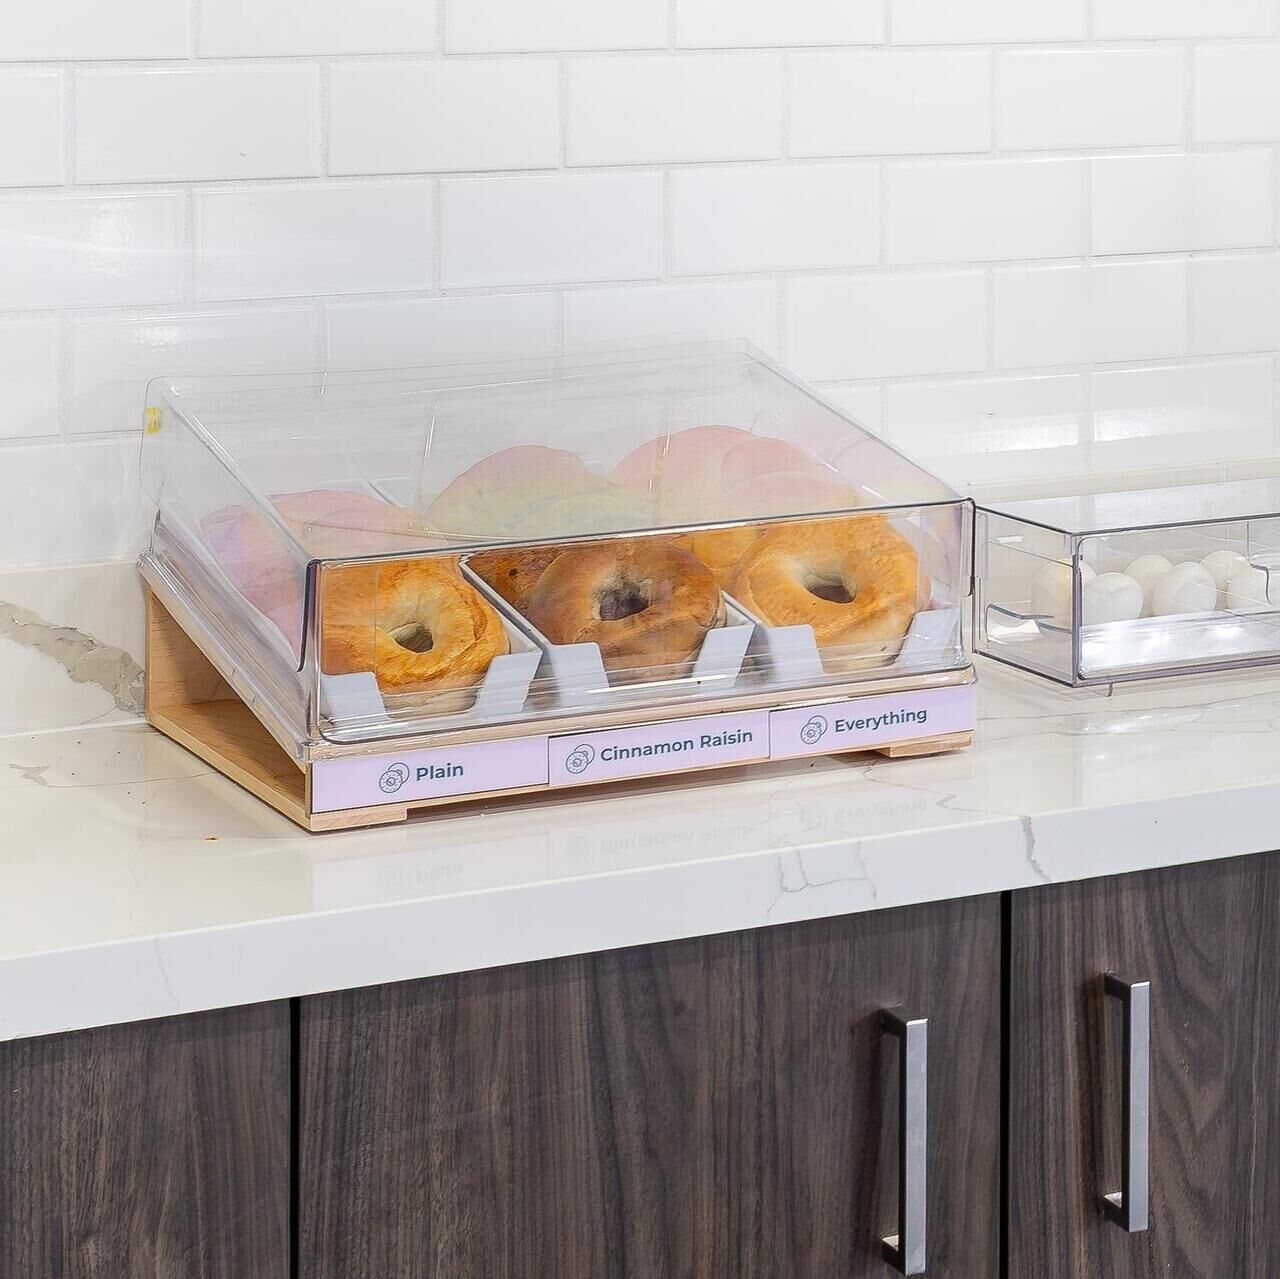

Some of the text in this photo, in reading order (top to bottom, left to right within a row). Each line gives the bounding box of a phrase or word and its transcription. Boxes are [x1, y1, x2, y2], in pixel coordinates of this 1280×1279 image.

[834, 708, 928, 734] Everything
[600, 729, 753, 762] Cinnamon Raisin
[415, 763, 464, 782] Plain
